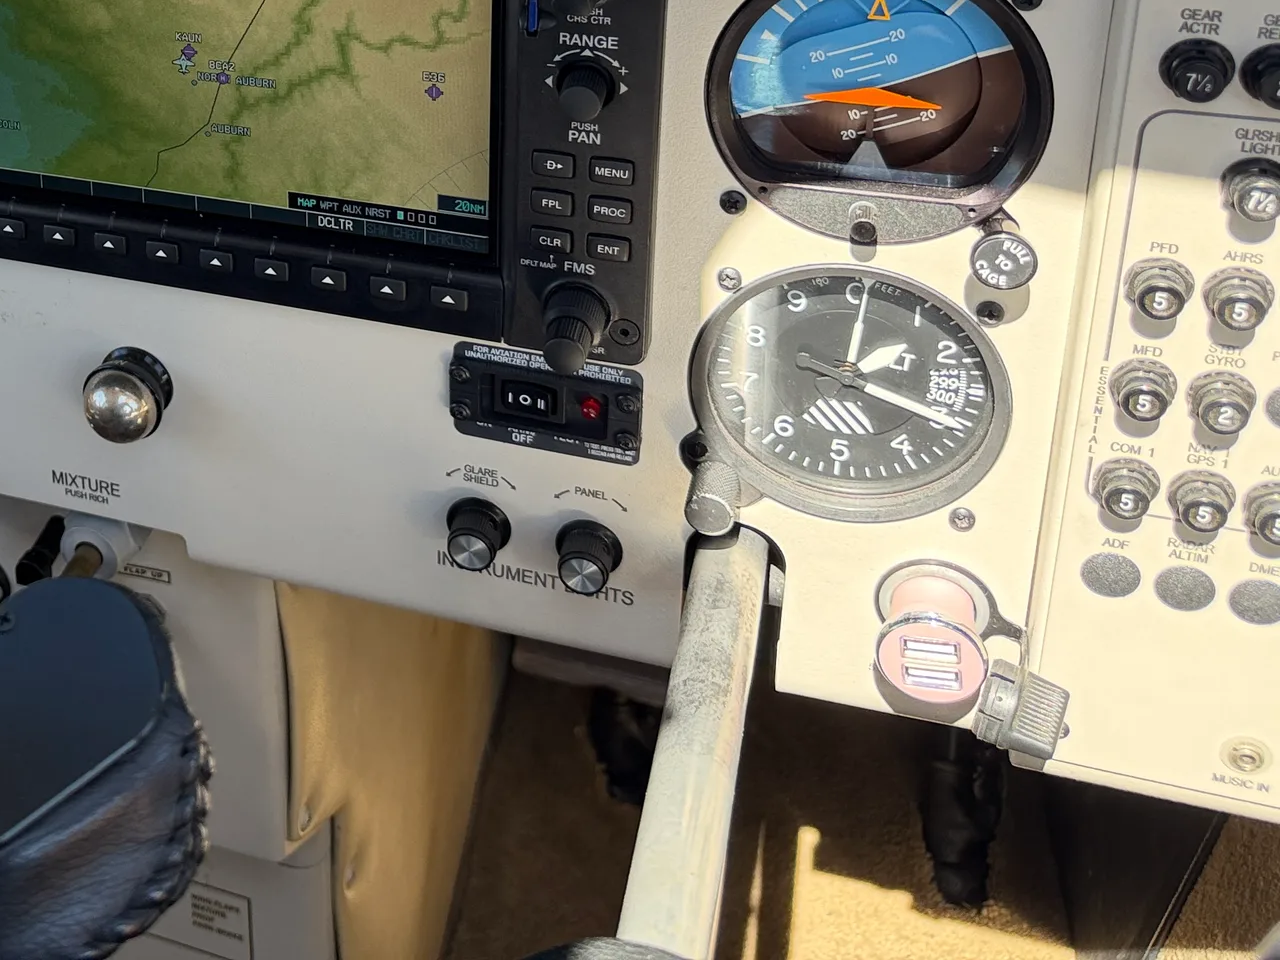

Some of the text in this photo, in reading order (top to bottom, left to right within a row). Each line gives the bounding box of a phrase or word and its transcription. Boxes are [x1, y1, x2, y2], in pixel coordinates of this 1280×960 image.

[1180, 8, 1222, 22] GEAR
[1178, 21, 1220, 35] ACTR
[175, 32, 202, 43] KAUN
[559, 32, 619, 49] RANGE
[236, 77, 276, 89] AUBURN
[422, 71, 445, 83] E36
[211, 123, 251, 137] AUBURN
[571, 122, 598, 131] PUSH
[568, 130, 601, 145] PAN
[595, 166, 629, 179] MENU
[298, 197, 391, 219] MAP AUX NRST
[454, 200, 485, 214] 20NM
[542, 199, 562, 210] FPL
[593, 205, 626, 218] PROC
[318, 216, 353, 232] DCLTR
[539, 236, 561, 247] CLR
[1150, 242, 1179, 254] PFD
[597, 244, 619, 256] ENT
[1002, 241, 1028, 265] PULL
[1223, 250, 1264, 264] AHRS
[564, 261, 595, 275] FMS
[994, 255, 1011, 270] TO
[974, 260, 1007, 286] CAGE
[874, 281, 901, 297] FEET
[473, 345, 528, 360] FOR AVIATION
[937, 341, 957, 364] 2
[1133, 344, 1163, 357] MFD
[465, 350, 528, 367] UNAUTHORIZED
[1205, 355, 1246, 369] GYRO
[578, 370, 632, 384] PROHIBITED
[602, 367, 624, 376] ONLY
[774, 415, 794, 437] 6
[512, 432, 534, 444] OFF
[830, 439, 851, 461] 5
[1110, 442, 1142, 456] COM
[464, 464, 498, 477] GLARE
[51, 470, 121, 497] MIXTURE
[463, 473, 499, 488] SHIELD
[89, 493, 110, 505] RICH
[574, 486, 608, 500] PANEL
[1101, 537, 1130, 550] ADF
[1168, 549, 1209, 564] ALTIM
[1212, 773, 1254, 791] MUSIC
